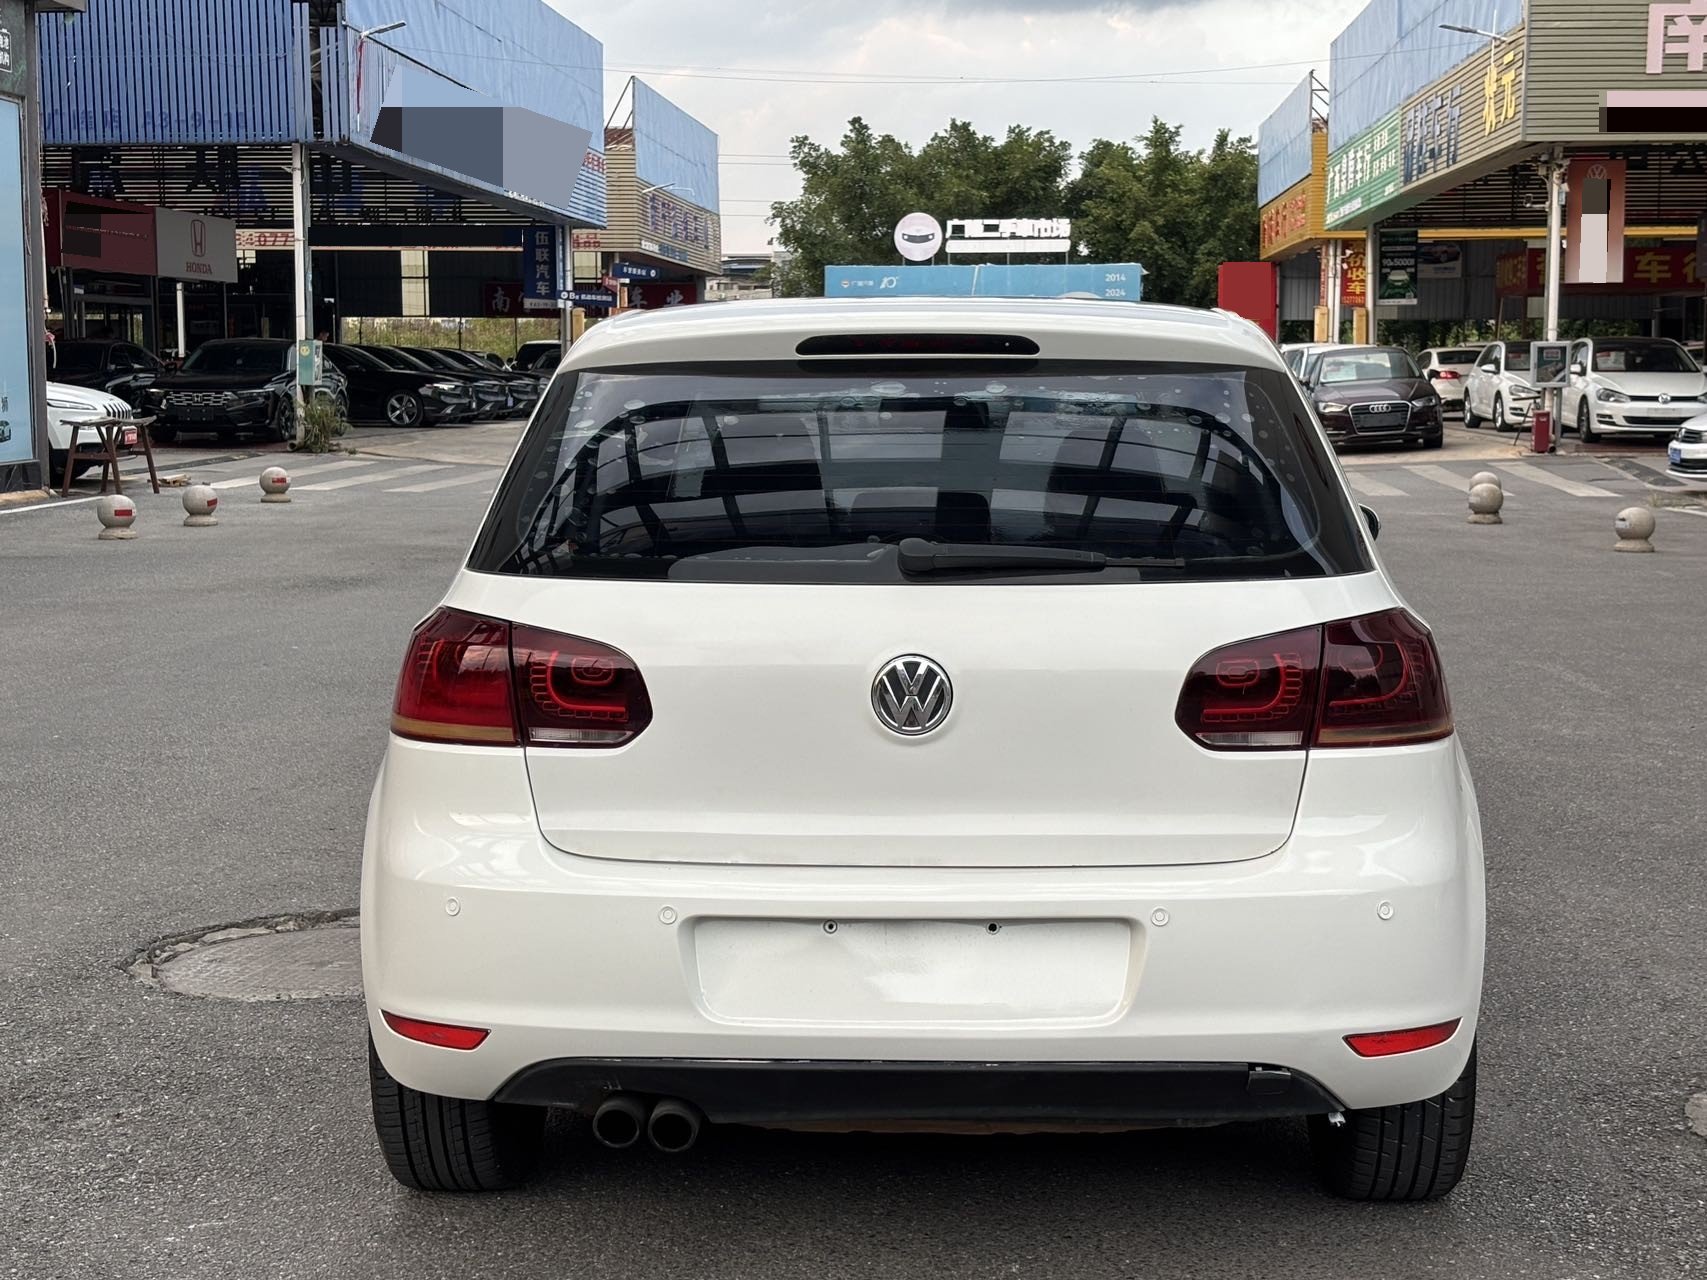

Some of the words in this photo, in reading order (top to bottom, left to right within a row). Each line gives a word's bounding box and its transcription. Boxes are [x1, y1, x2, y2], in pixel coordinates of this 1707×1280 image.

[1483, 51, 1515, 136] 状元
[186, 262, 213, 275] HONDA
[534, 231, 550, 296] 伍联汽车
[1104, 274, 1127, 283] 2014
[1104, 288, 1127, 297] 2024
